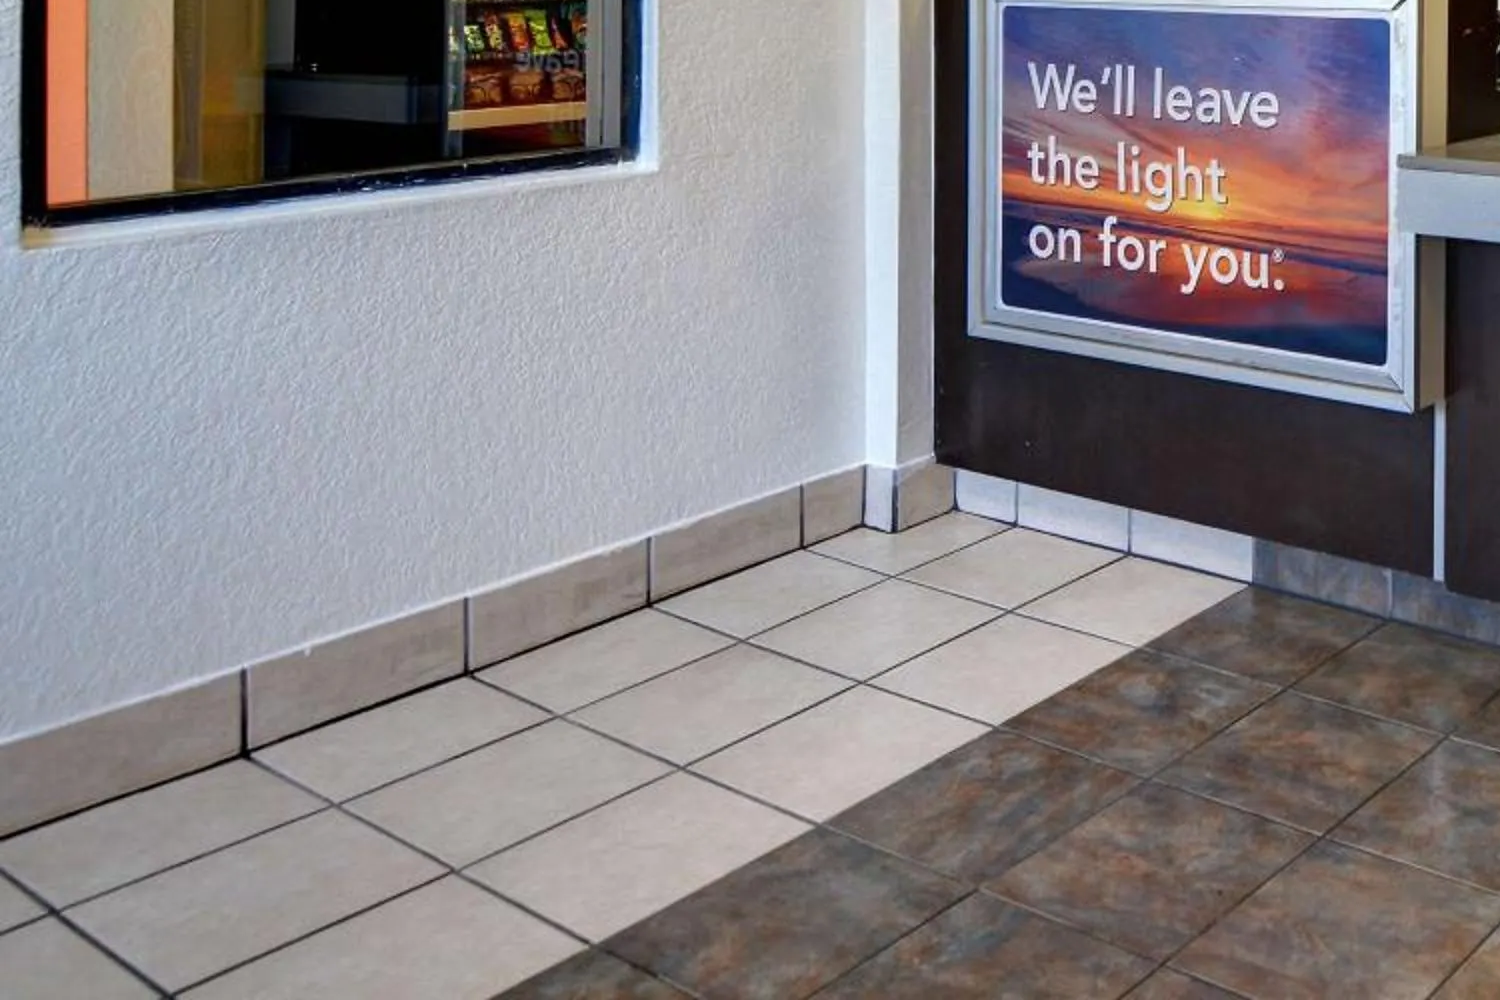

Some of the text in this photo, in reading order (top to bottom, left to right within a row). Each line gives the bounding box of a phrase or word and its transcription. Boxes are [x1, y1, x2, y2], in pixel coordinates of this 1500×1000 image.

[1027, 62, 1279, 127] We'll leave
[1026, 135, 1229, 212] the light
[1028, 223, 1082, 264] on
[1098, 216, 1167, 274] for
